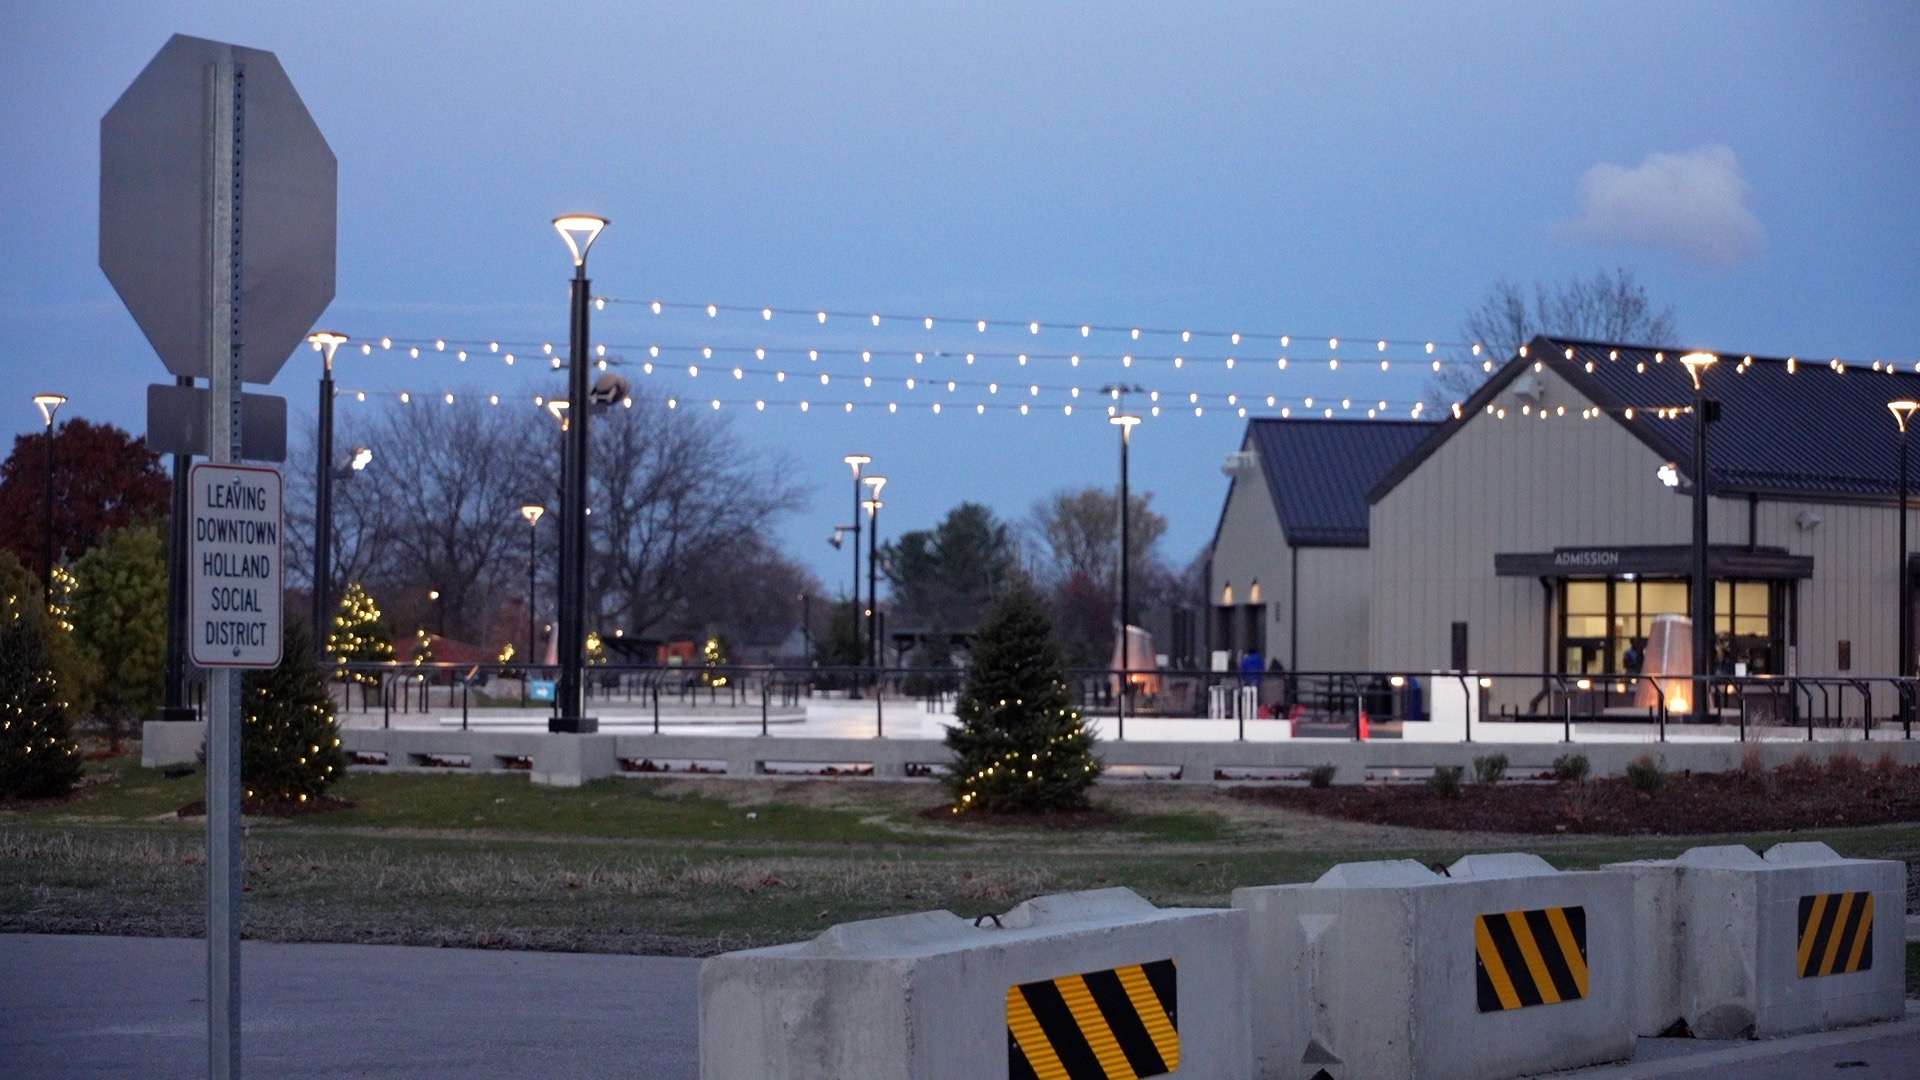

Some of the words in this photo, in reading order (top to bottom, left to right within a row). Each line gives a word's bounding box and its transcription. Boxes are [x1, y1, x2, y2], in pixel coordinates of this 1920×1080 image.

[207, 484, 266, 511] LEAVING
[197, 518, 276, 545] DOWNTOWN
[203, 553, 270, 578] HOLLAND
[1555, 552, 1619, 566] ADMISSION
[211, 587, 262, 612] SOCIAL
[206, 621, 267, 646] DISTRICT
